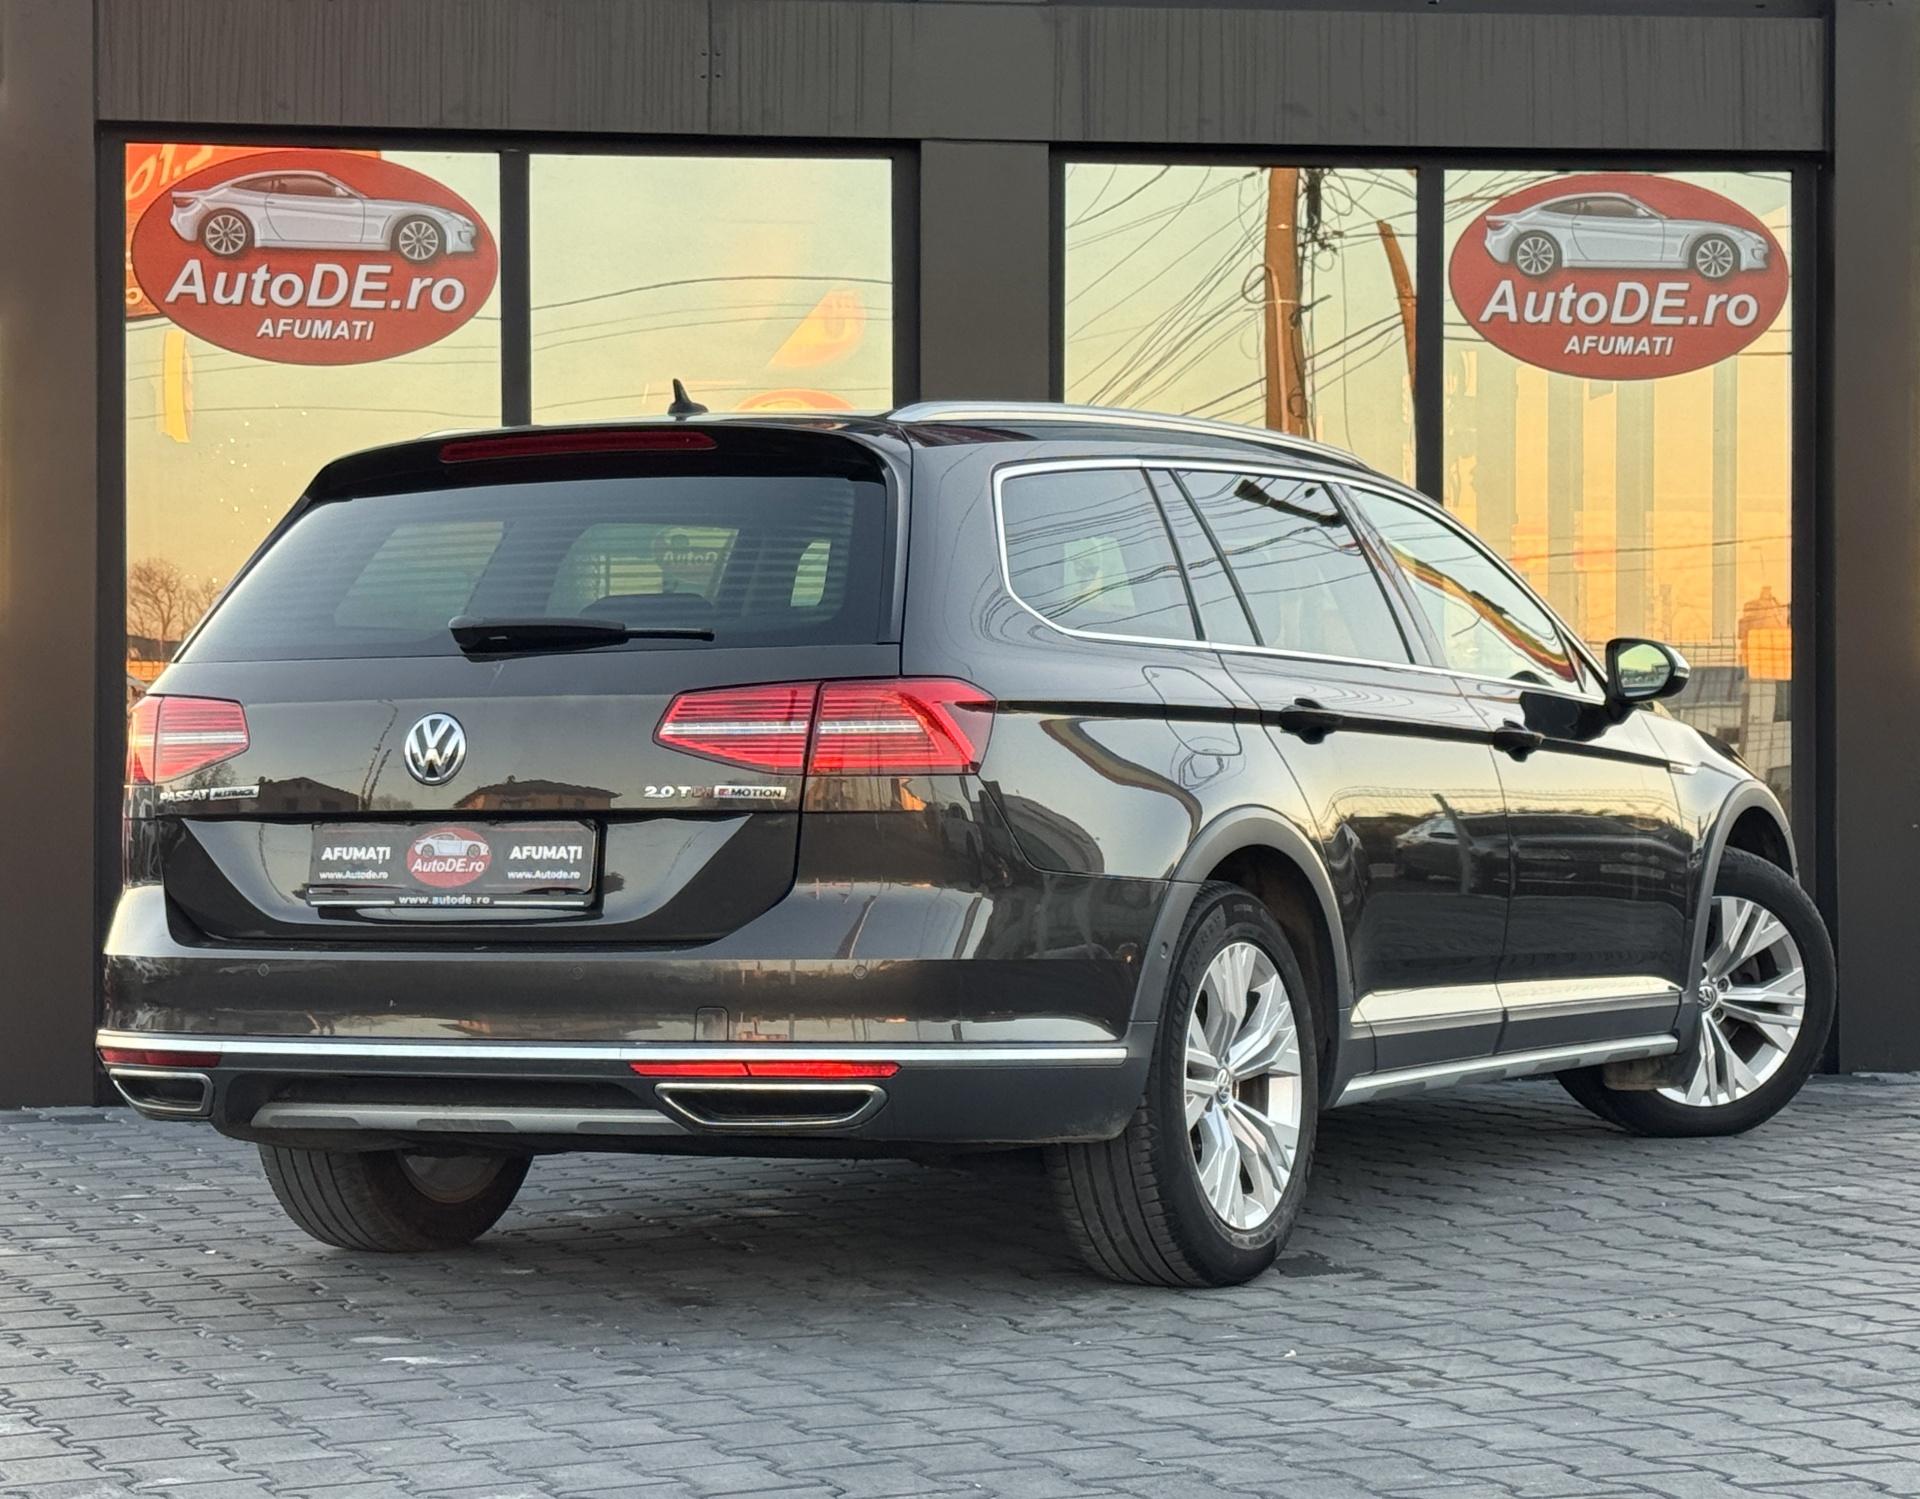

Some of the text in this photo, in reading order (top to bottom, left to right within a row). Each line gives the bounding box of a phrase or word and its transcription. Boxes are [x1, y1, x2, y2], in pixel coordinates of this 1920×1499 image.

[165, 258, 466, 313] AutoDE.ro
[1479, 278, 1760, 327] AutoDE.ro
[256, 317, 375, 342] AFUMATI
[1563, 335, 1674, 357] AFUMATI
[160, 789, 210, 802] PASSAT
[320, 846, 391, 865] AFUMAȚI
[508, 845, 584, 864] AFUMAȚI
[318, 869, 389, 881] www.Autode.ro
[410, 857, 486, 874] AutoDE.ro
[507, 869, 581, 880] www.Autode.ro
[398, 895, 491, 905] www.autode.ro
